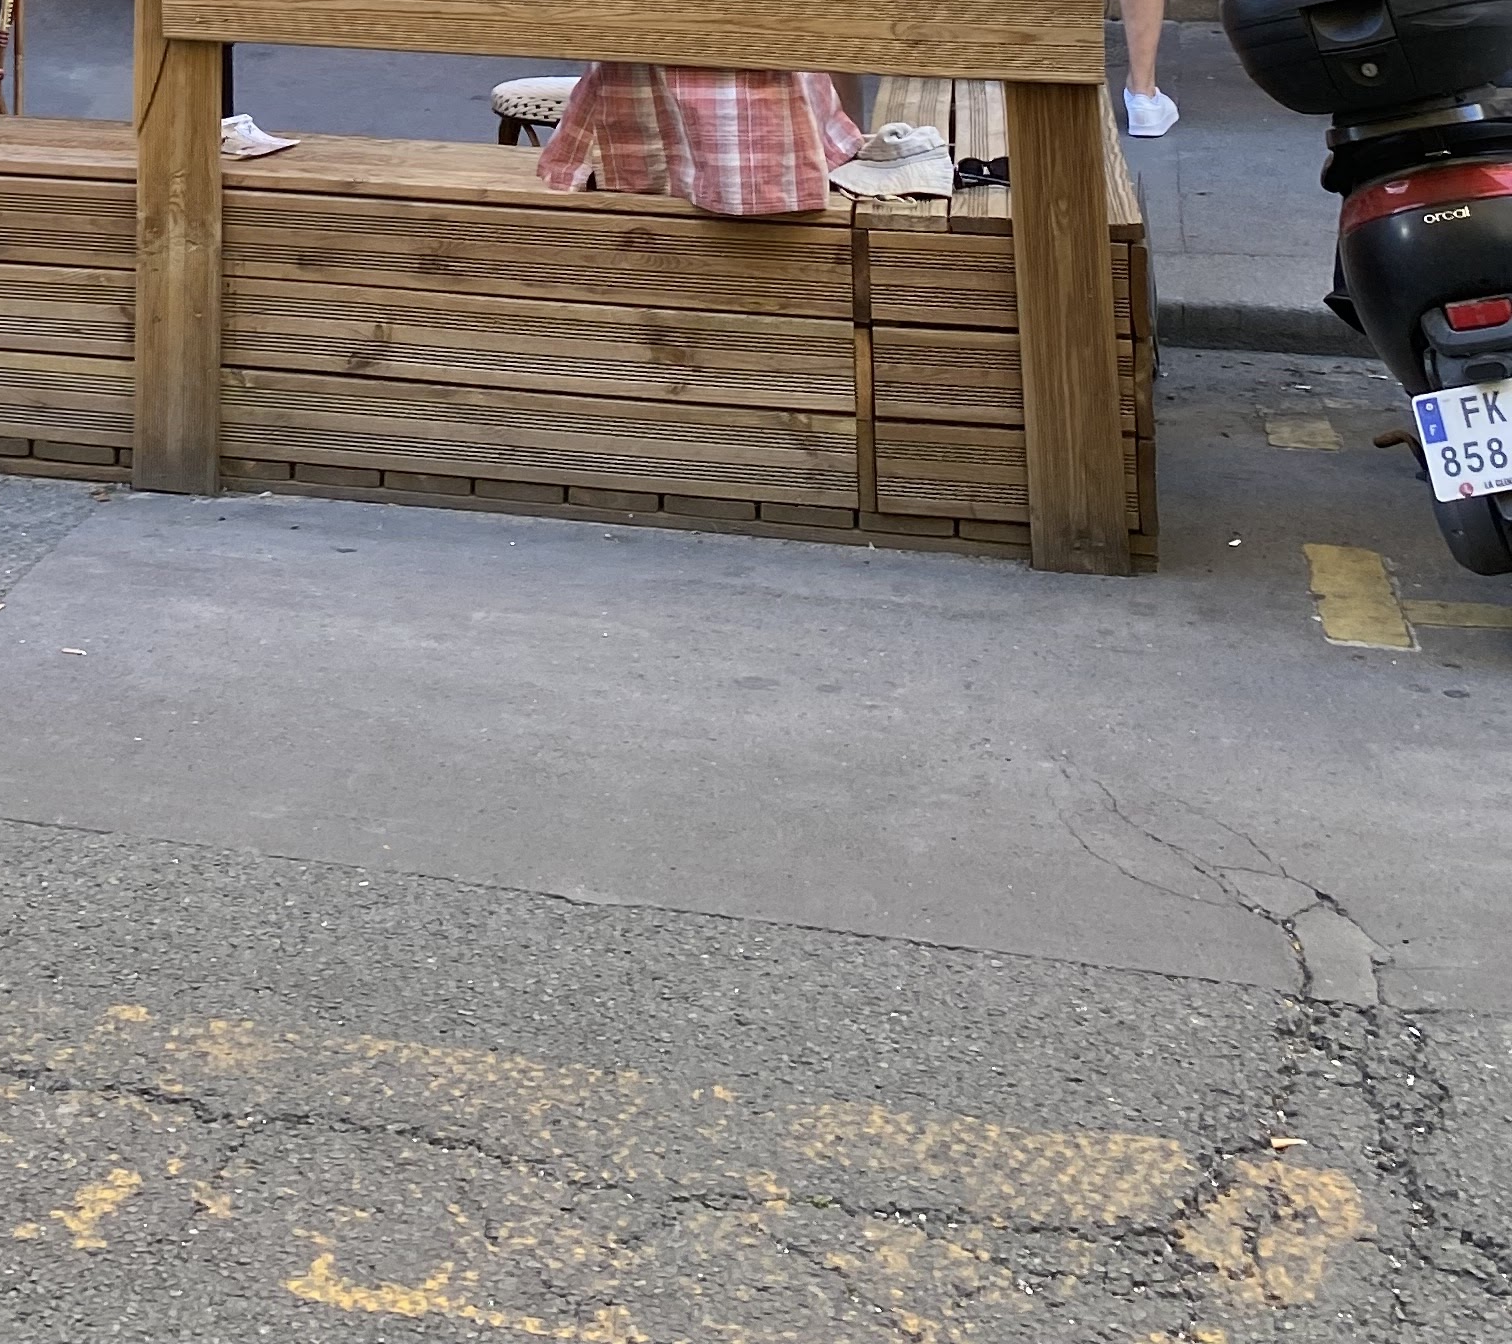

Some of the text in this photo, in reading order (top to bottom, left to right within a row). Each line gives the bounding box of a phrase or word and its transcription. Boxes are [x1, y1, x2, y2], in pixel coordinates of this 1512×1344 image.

[1423, 205, 1472, 225] orcal
[1459, 390, 1508, 429] FK
[1441, 437, 1508, 478] 858
